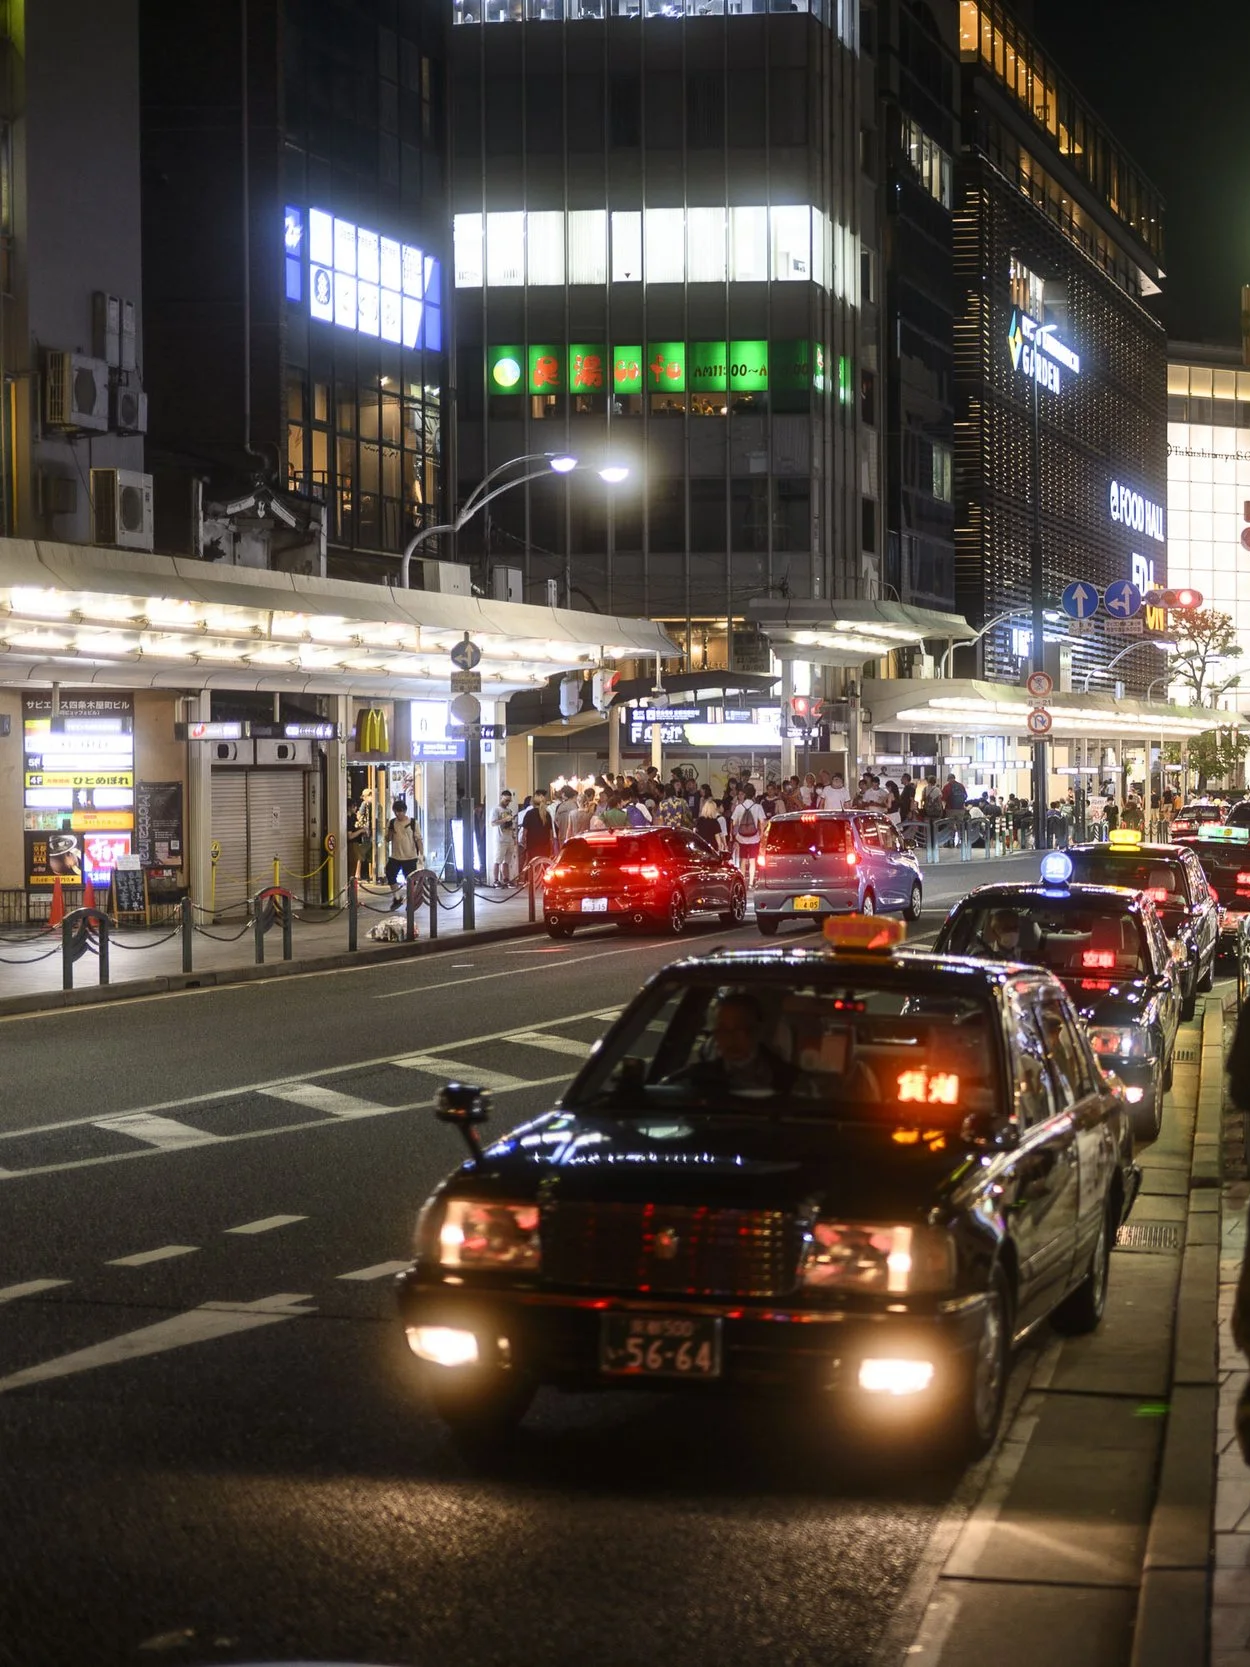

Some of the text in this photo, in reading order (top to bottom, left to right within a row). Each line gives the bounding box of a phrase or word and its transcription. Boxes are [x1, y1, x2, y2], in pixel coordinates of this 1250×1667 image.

[1144, 499, 1165, 543] HALL
[73, 776, 128, 785] ひとめぼれ
[626, 1337, 712, 1371] 56-64
